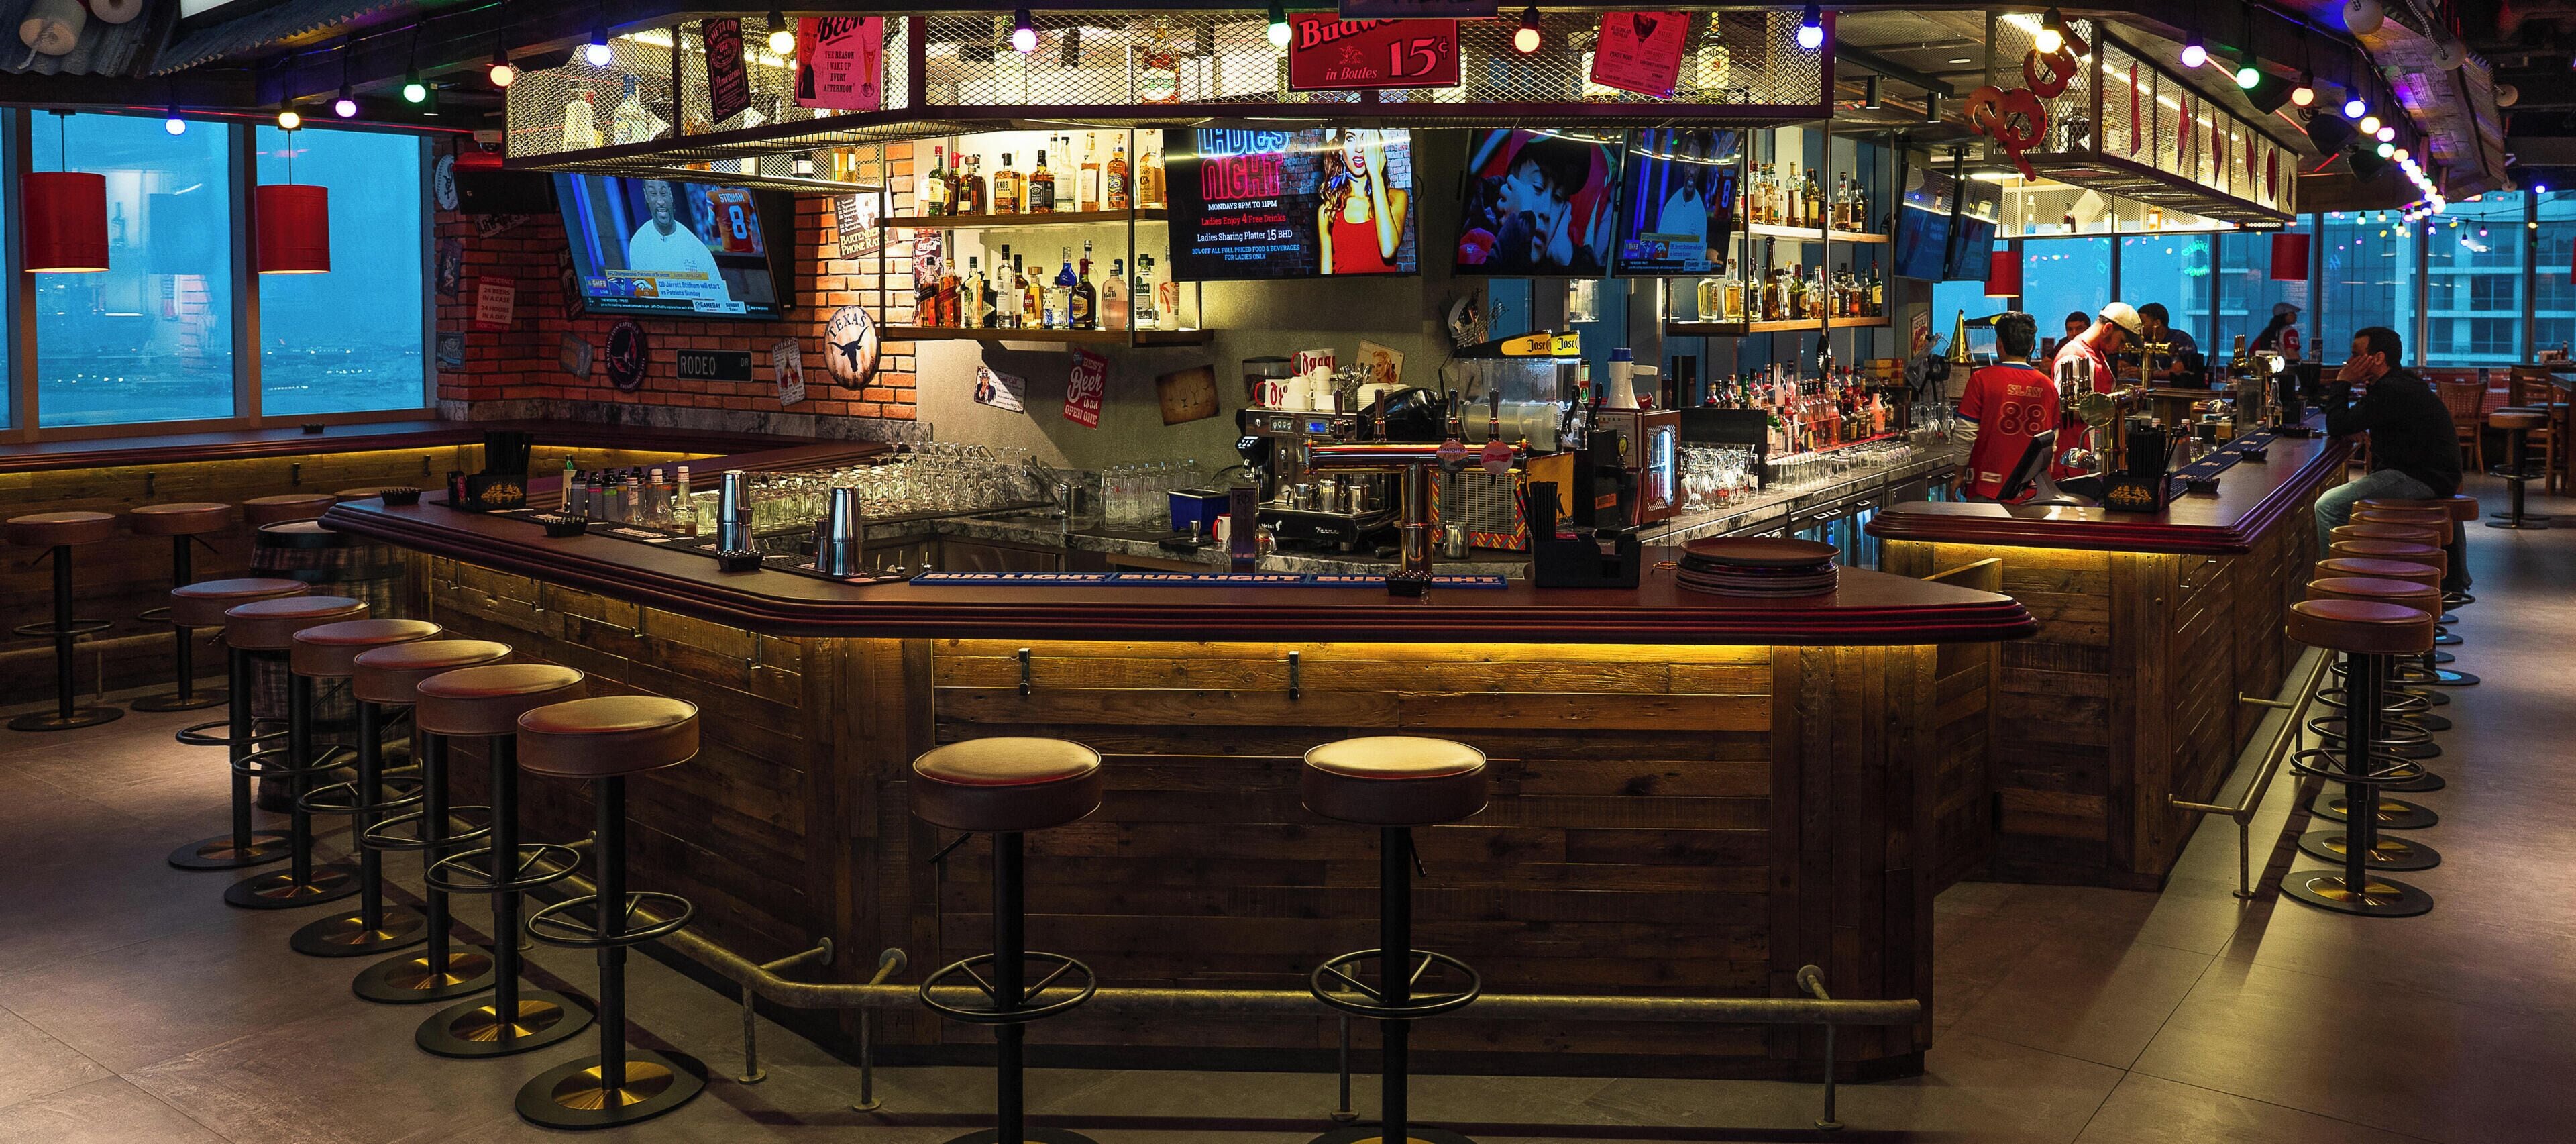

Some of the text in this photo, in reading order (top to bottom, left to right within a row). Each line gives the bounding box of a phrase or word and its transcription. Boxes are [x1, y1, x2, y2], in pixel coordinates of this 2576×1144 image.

[708, 21, 726, 44] THETA
[727, 20, 737, 32] CHI
[830, 62, 843, 70] WAKE
[844, 62, 851, 70] UP
[1326, 66, 1378, 81] in Bottles
[715, 69, 741, 87] American
[830, 73, 846, 81] EVERY
[1202, 152, 1283, 200] NIGHT
[719, 193, 744, 203] STIDHAM
[1721, 179, 1731, 208] 8
[1208, 203, 1237, 211] MONDAYS
[729, 205, 747, 239] 8
[1201, 213, 1286, 225] Ladies Enjoy 4 Free Drinks
[1197, 229, 1293, 242] Ladies Sharing Platter 15 BHD
[841, 234, 889, 255] PHONE RATS
[828, 313, 866, 338] TEXAS
[773, 338, 797, 351] CHEERS
[1527, 338, 1546, 353] Jose
[1557, 337, 1575, 351] Jose
[680, 355, 749, 375] RODEO DR
[1083, 358, 1104, 371] BEST
[1067, 366, 1102, 403] Beer
[2007, 384, 2043, 397] SLAY
[1083, 397, 1099, 410] is an
[1065, 405, 1097, 425] OPEN ONE
[1998, 401, 2047, 437] 88
